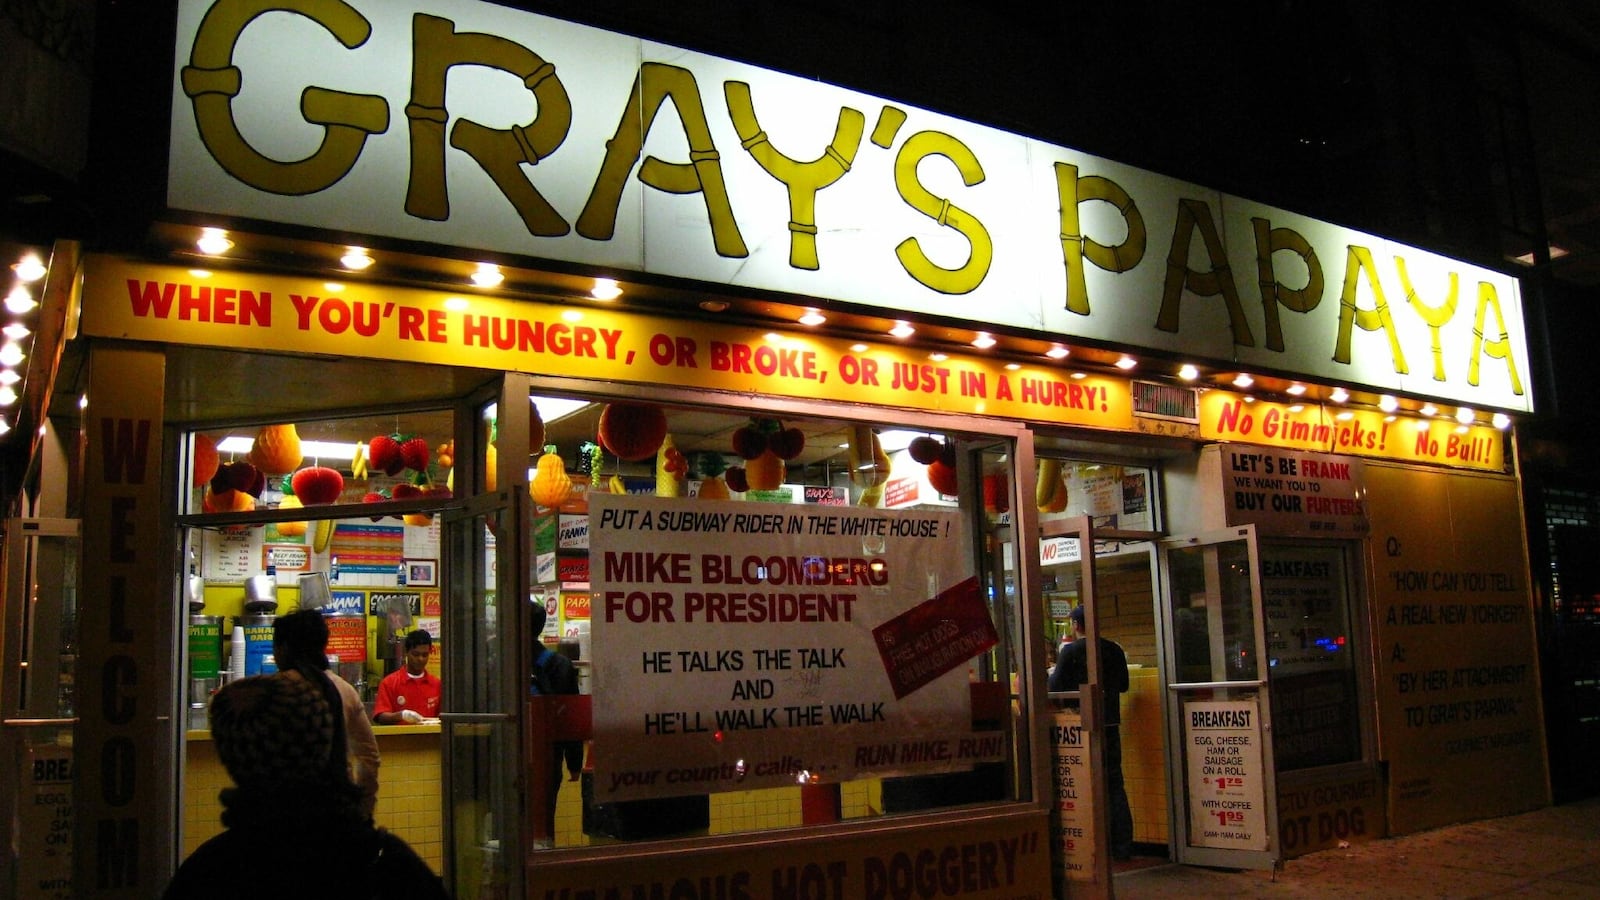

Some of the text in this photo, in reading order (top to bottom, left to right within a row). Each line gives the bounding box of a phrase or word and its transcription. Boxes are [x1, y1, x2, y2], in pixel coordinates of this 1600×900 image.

[181, 0, 1524, 396] GRAY'S PAPAYA
[127, 278, 1110, 415] WHEN YOU'RE HUNGRY, OR BROKE, OR JUST IN A HURRY!
[1217, 400, 1252, 435] No
[1263, 407, 1388, 451] Gimmicks!
[1415, 429, 1493, 464] No Bull!
[1231, 453, 1351, 480] LET'S BE FRANK
[1234, 476, 1321, 493] WE WANT YOU TO
[1235, 491, 1364, 515] BUY OUR FURTERS
[600, 509, 639, 531] PUT
[640, 511, 654, 531] A
[657, 511, 732, 533] SUBWAY
[734, 513, 784, 534] RIDER
[787, 515, 804, 535] IN
[807, 517, 837, 536] THE
[840, 518, 887, 537] WHITE
[889, 519, 940, 538] HOUSE
[1042, 543, 1057, 560] NO
[1386, 537, 1402, 557] Q:
[604, 552, 889, 586] MIKE BLOOMBERG
[1263, 561, 1330, 577] EAKFAST
[1432, 571, 1458, 592] CAN
[1462, 572, 1487, 592] YOU
[1490, 573, 1517, 592] TELL
[606, 592, 857, 623] FOR PRESIDENT
[1387, 605, 1397, 625] A
[1401, 604, 1436, 625] REAL
[1439, 604, 1467, 625] NEW
[642, 648, 846, 674] HE TALKS THE TALK
[1392, 642, 1406, 663] A:
[1423, 670, 1449, 691] HER
[1452, 664, 1527, 689] ATTACHMENT
[731, 679, 775, 701] AND
[645, 702, 886, 735] HE'LL WALK THE WALK
[1191, 710, 1252, 728] BREAKFAST
[1405, 706, 1425, 728] TO
[855, 737, 1003, 768] RUN MIKE, RUN!
[1194, 736, 1252, 747] EGG, CHEESE,
[1206, 746, 1240, 755] HAM OR
[1202, 766, 1247, 776] ON A ROLL
[1204, 756, 1243, 766] SAUSAGE
[608, 768, 662, 792] your
[666, 764, 747, 785] country
[1202, 800, 1252, 810] WITH COFFEE
[1318, 806, 1365, 841] DOG
